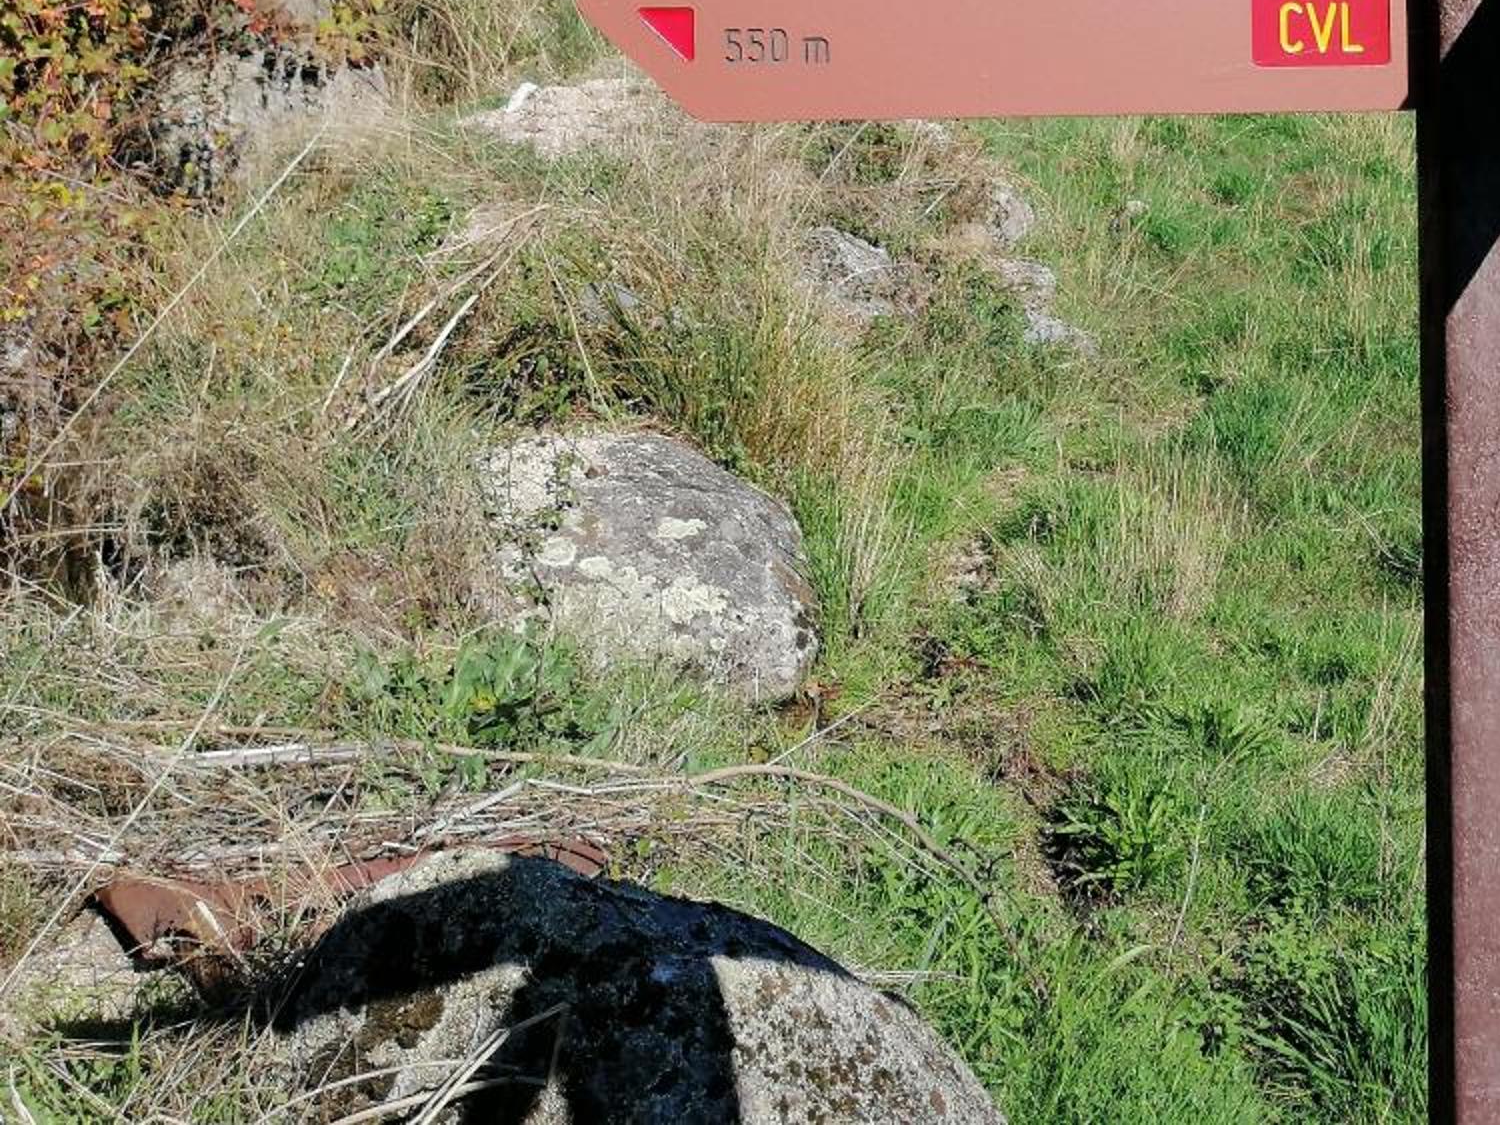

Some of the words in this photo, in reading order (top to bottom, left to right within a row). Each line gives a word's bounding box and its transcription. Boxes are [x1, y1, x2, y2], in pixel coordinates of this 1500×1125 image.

[724, 27, 789, 63] 550
[803, 36, 831, 64] m
[1279, 2, 1365, 54] CVL
